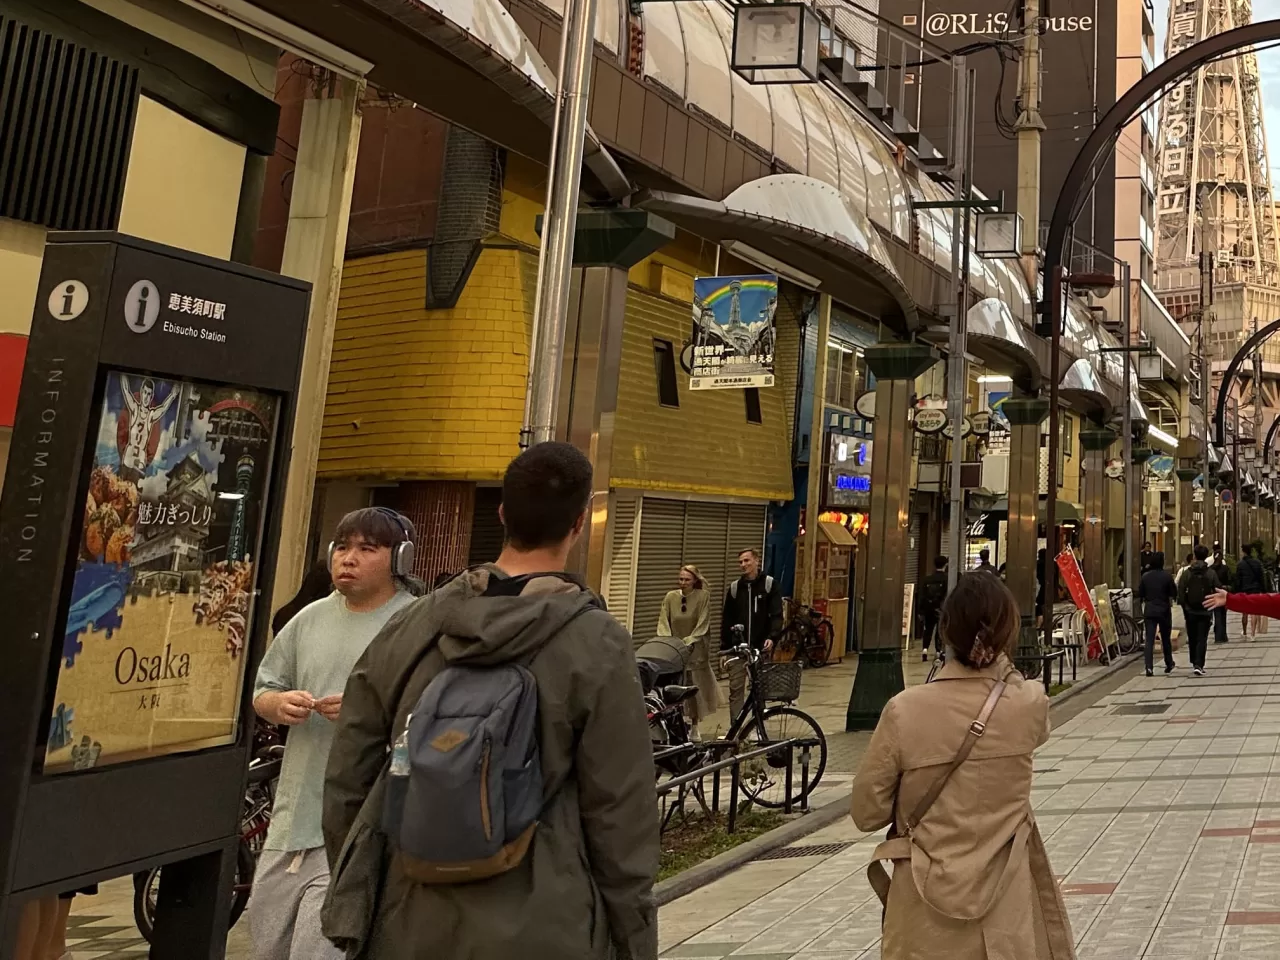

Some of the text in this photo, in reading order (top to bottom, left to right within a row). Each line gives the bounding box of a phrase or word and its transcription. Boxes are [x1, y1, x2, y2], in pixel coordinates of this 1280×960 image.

[168, 292, 227, 321] 恵美須町駅
[163, 321, 226, 343] Ebisucho Station
[693, 345, 735, 356] 新世界一
[130, 421, 145, 459] グリコ
[16, 358, 65, 562] INFORMATION
[136, 501, 213, 527] 魅力ぎっしり
[114, 643, 191, 685] Osaka
[136, 695, 161, 711] 大阪
